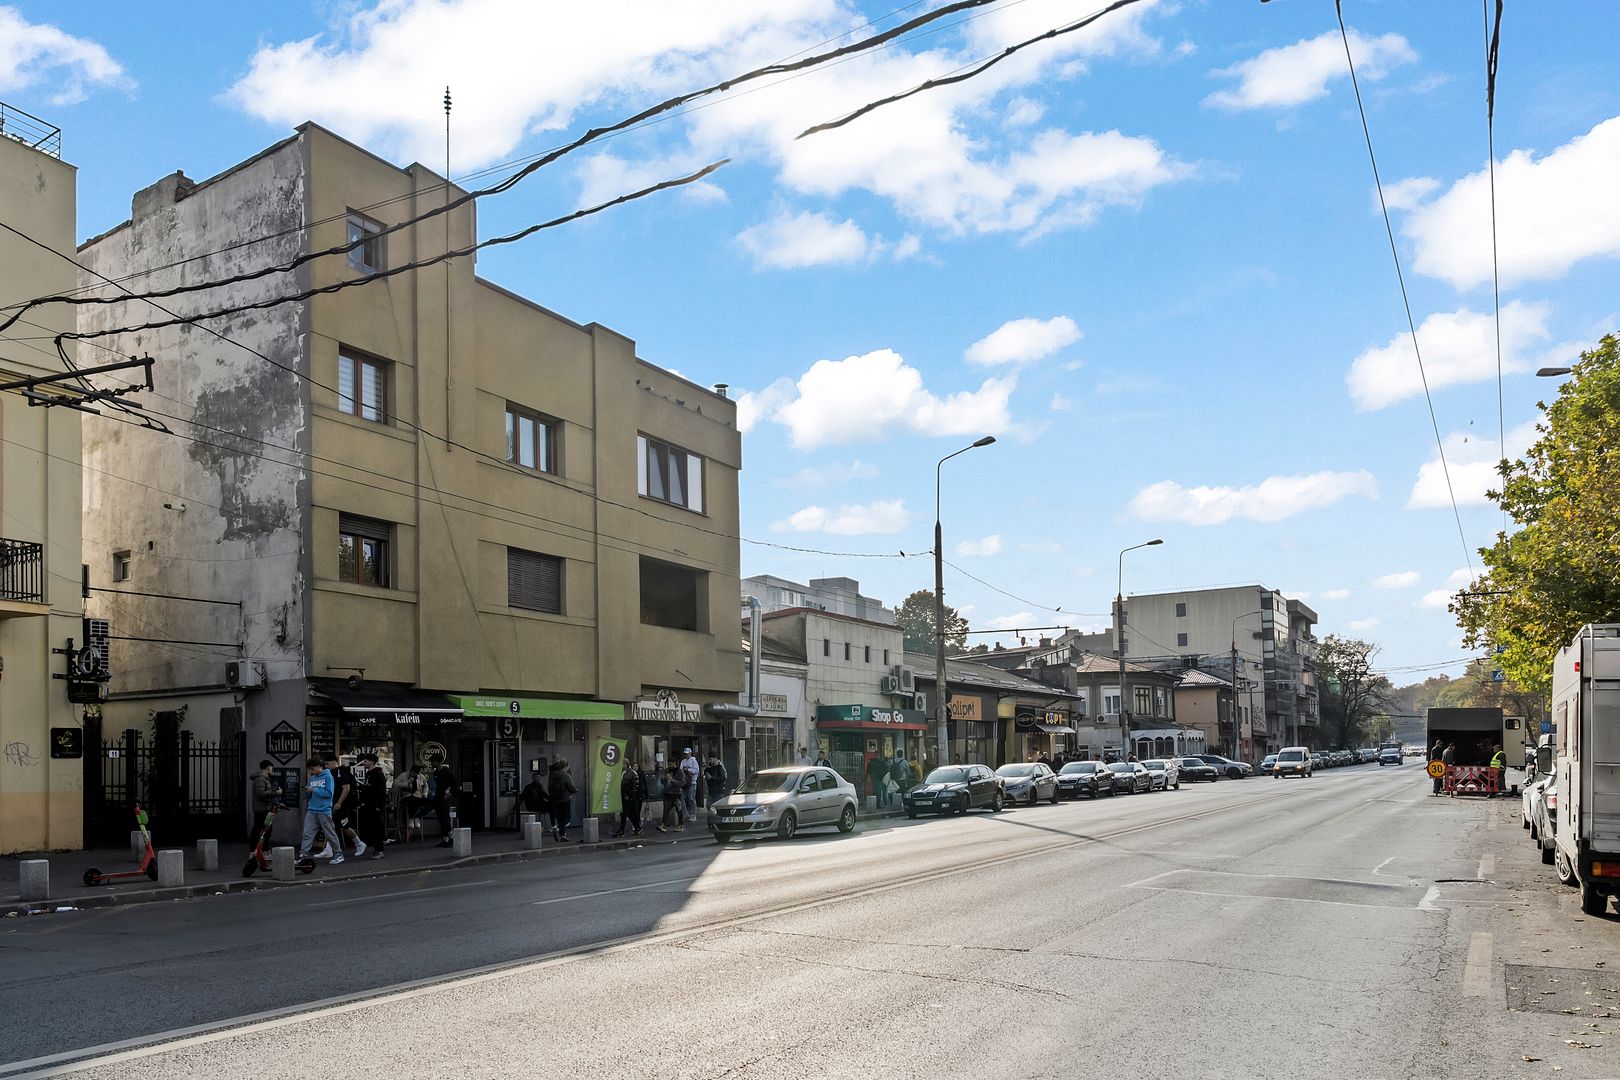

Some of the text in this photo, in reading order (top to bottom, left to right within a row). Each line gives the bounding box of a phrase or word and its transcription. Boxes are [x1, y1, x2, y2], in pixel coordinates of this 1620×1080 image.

[394, 713, 421, 724] kafein
[872, 709, 904, 724] Shop Go
[504, 719, 513, 735] 5
[606, 745, 615, 760] 5
[1431, 764, 1443, 774] 30
